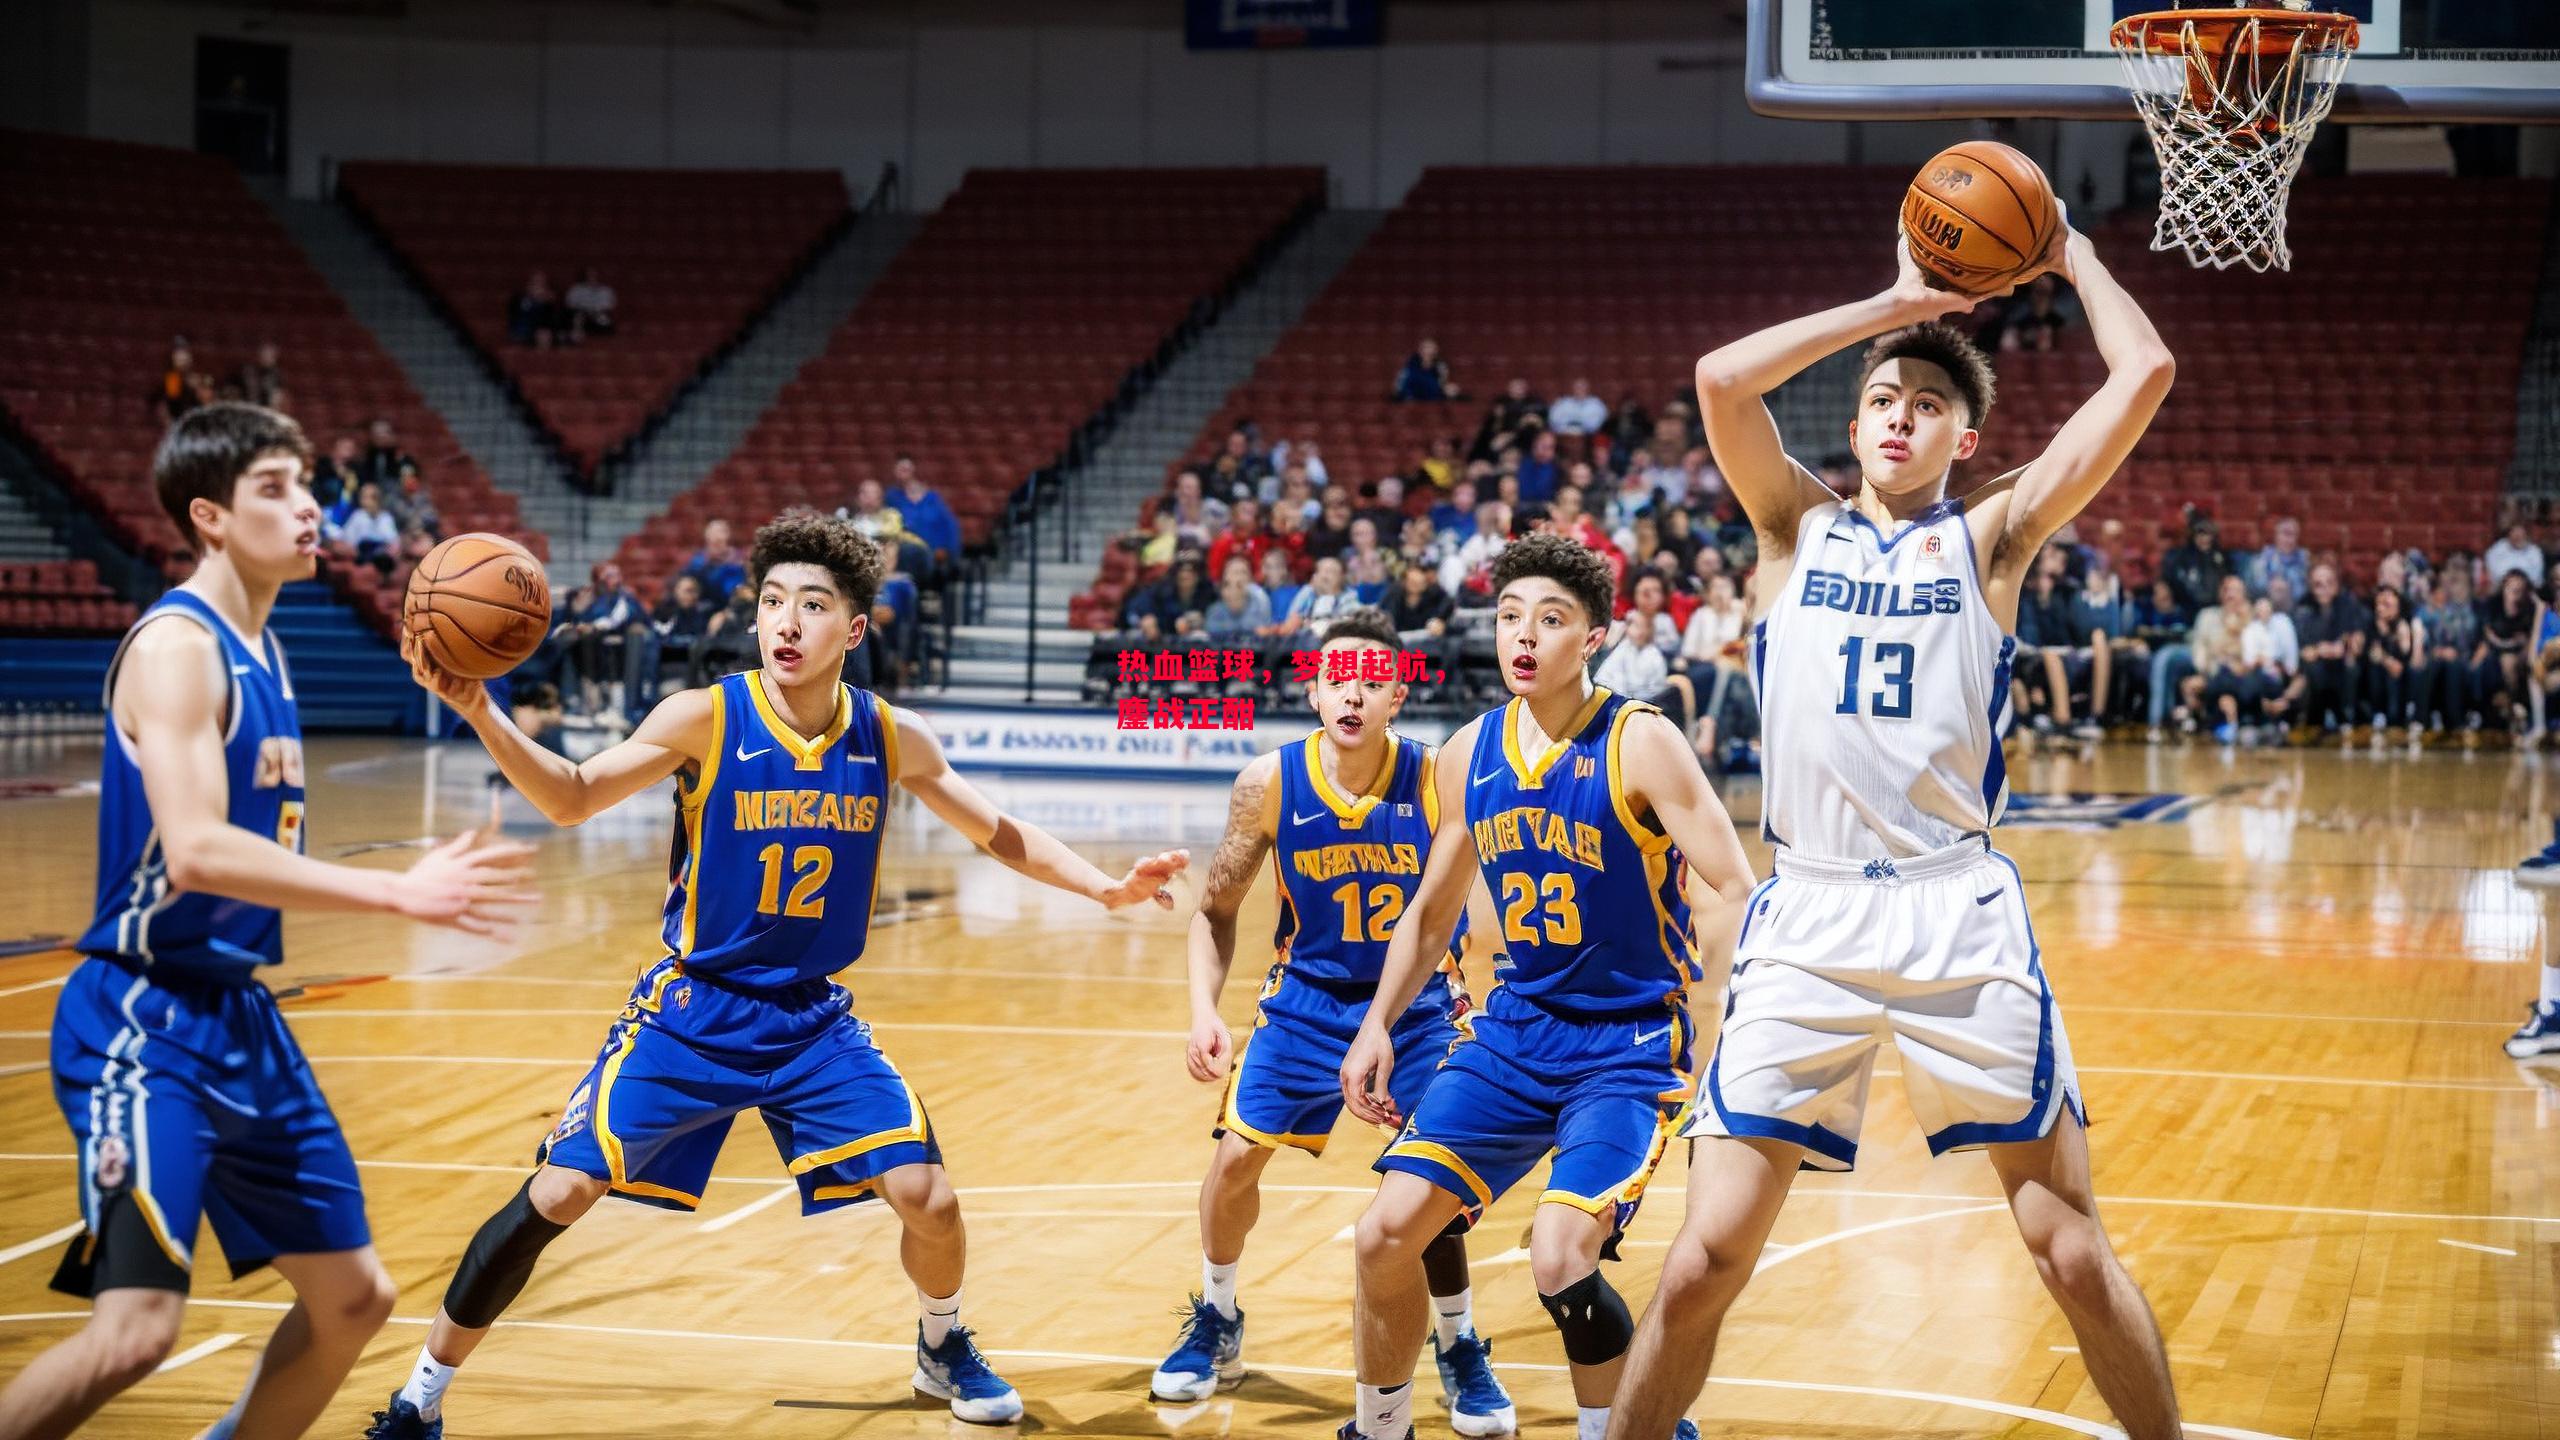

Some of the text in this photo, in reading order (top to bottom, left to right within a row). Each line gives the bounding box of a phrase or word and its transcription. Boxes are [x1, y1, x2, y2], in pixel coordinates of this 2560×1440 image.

[1836, 635, 1915, 719] 13
[757, 843, 833, 918] 12
[1332, 882, 1404, 942] 12
[1502, 872, 1582, 946] 23
